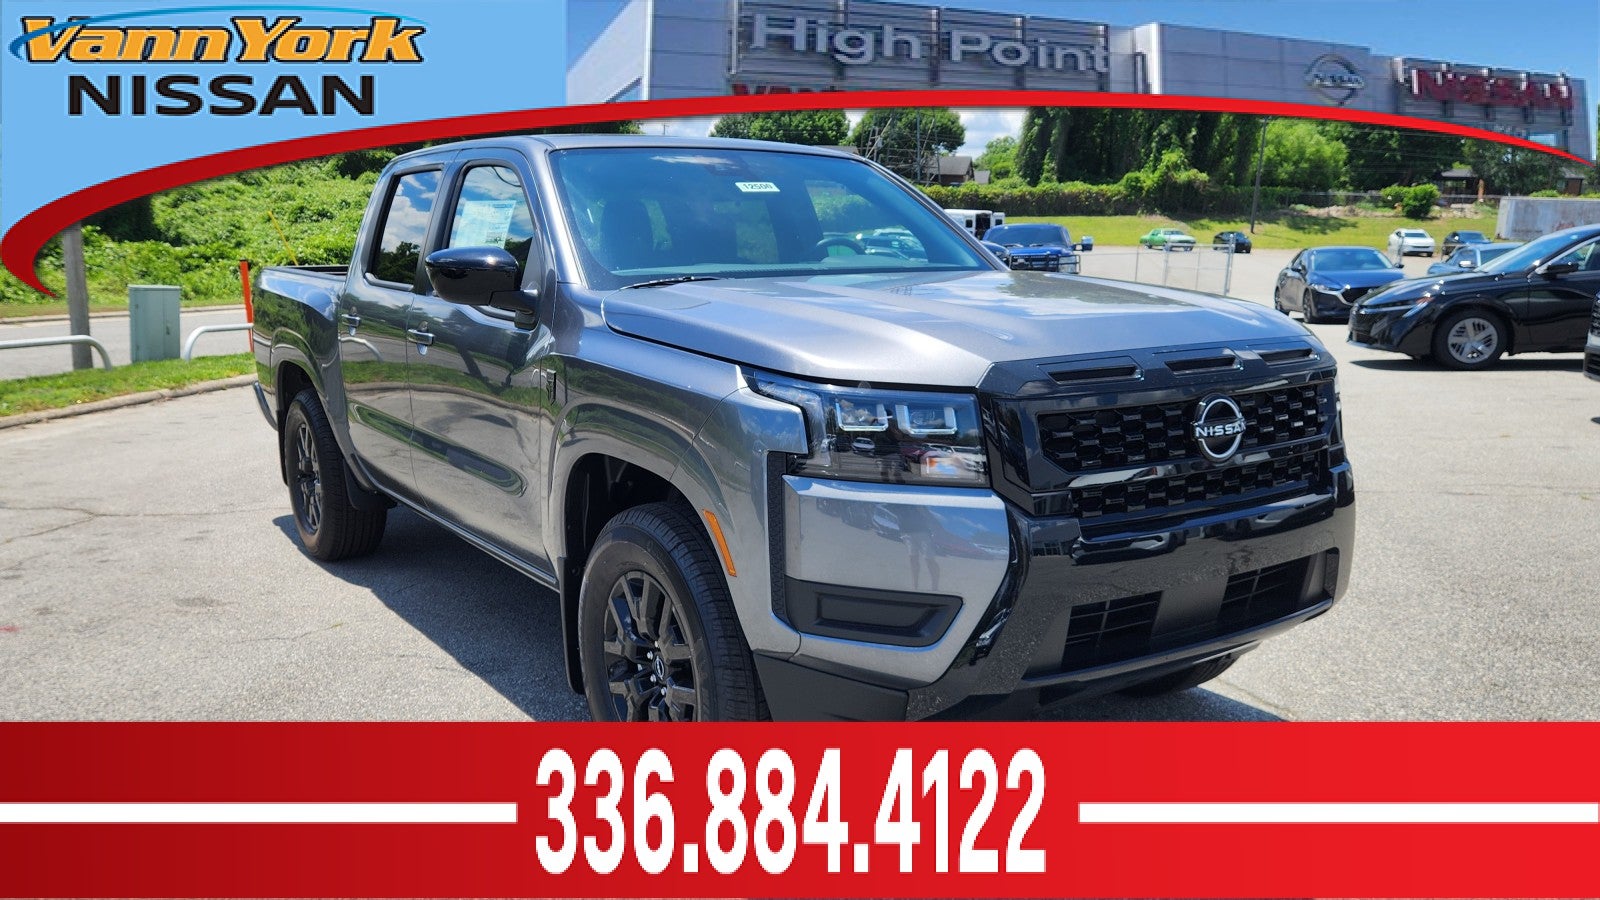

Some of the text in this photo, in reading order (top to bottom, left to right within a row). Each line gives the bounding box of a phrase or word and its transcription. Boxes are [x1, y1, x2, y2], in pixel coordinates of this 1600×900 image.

[752, 13, 1110, 73] High Point
[1195, 421, 1246, 437] NISSAN
